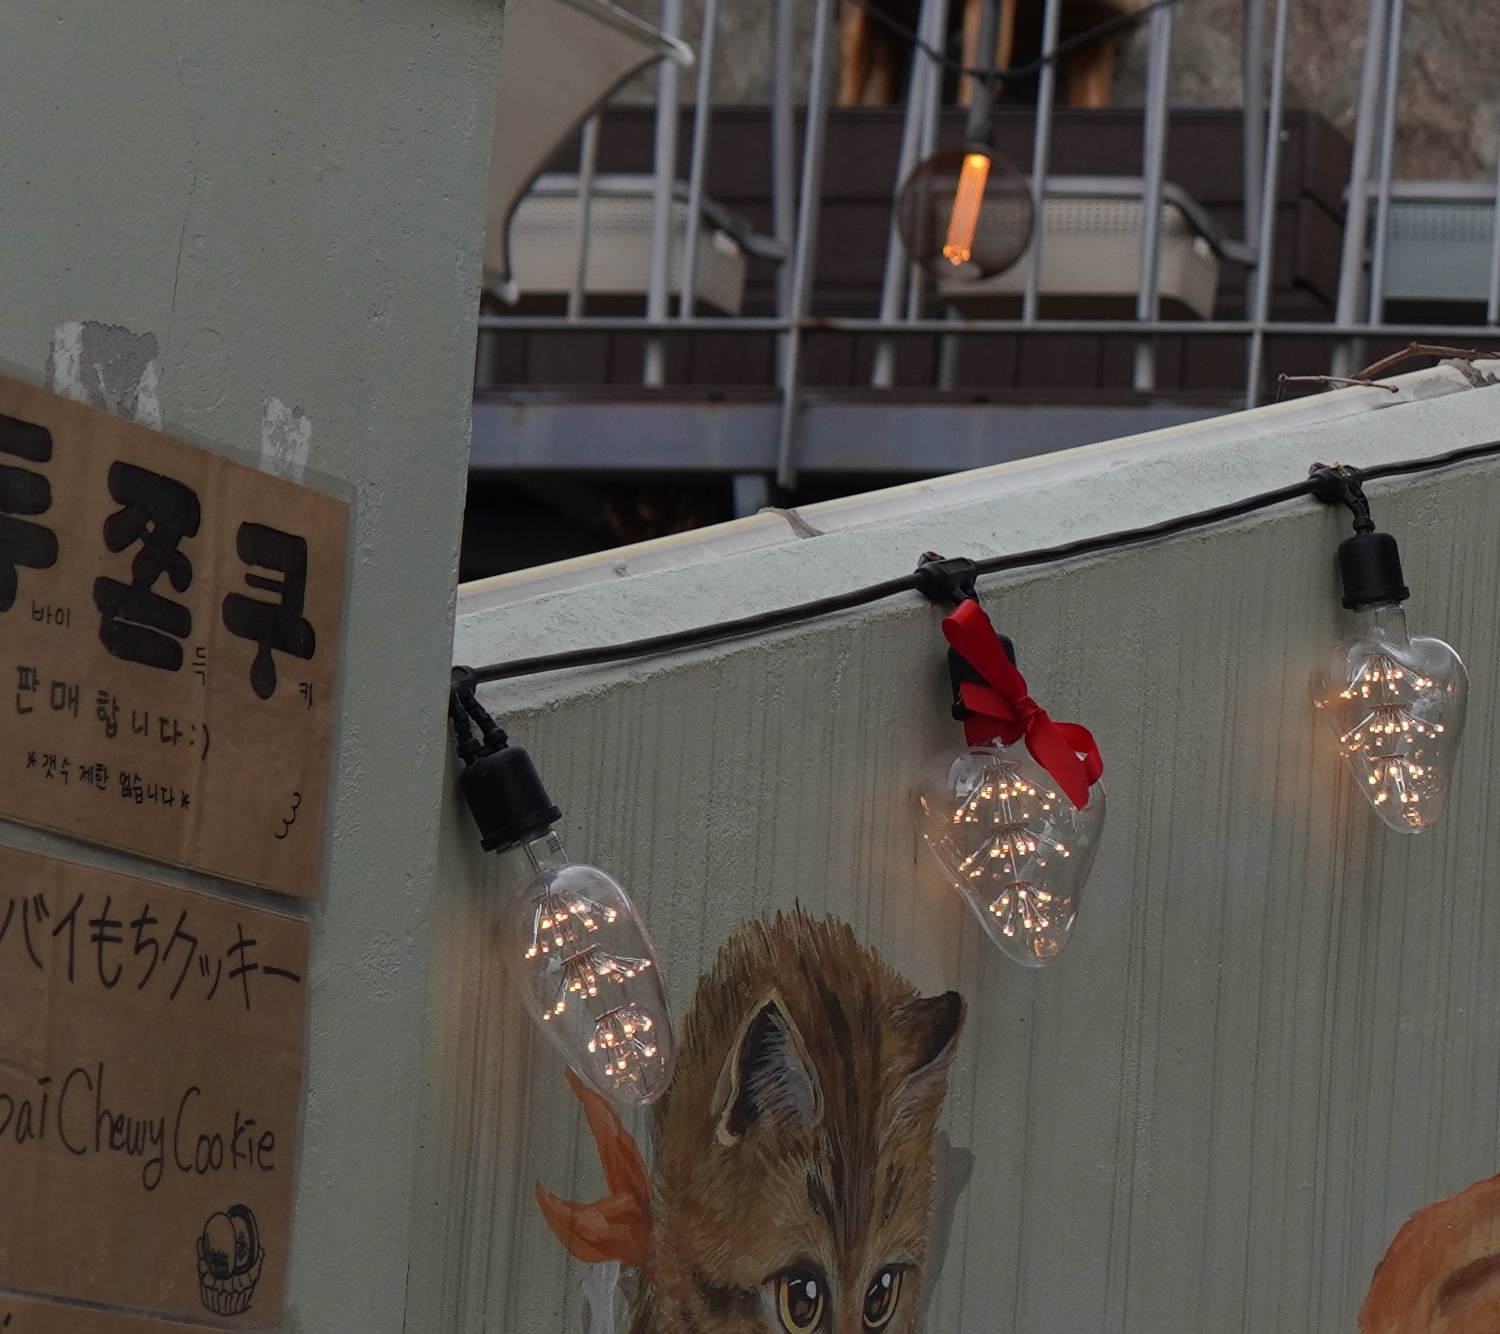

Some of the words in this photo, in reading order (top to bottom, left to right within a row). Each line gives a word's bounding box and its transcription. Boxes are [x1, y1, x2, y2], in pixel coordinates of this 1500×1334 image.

[32, 599, 71, 629] 바이
[57, 1061, 167, 1192] Chewy
[174, 1085, 276, 1175] Cookie
